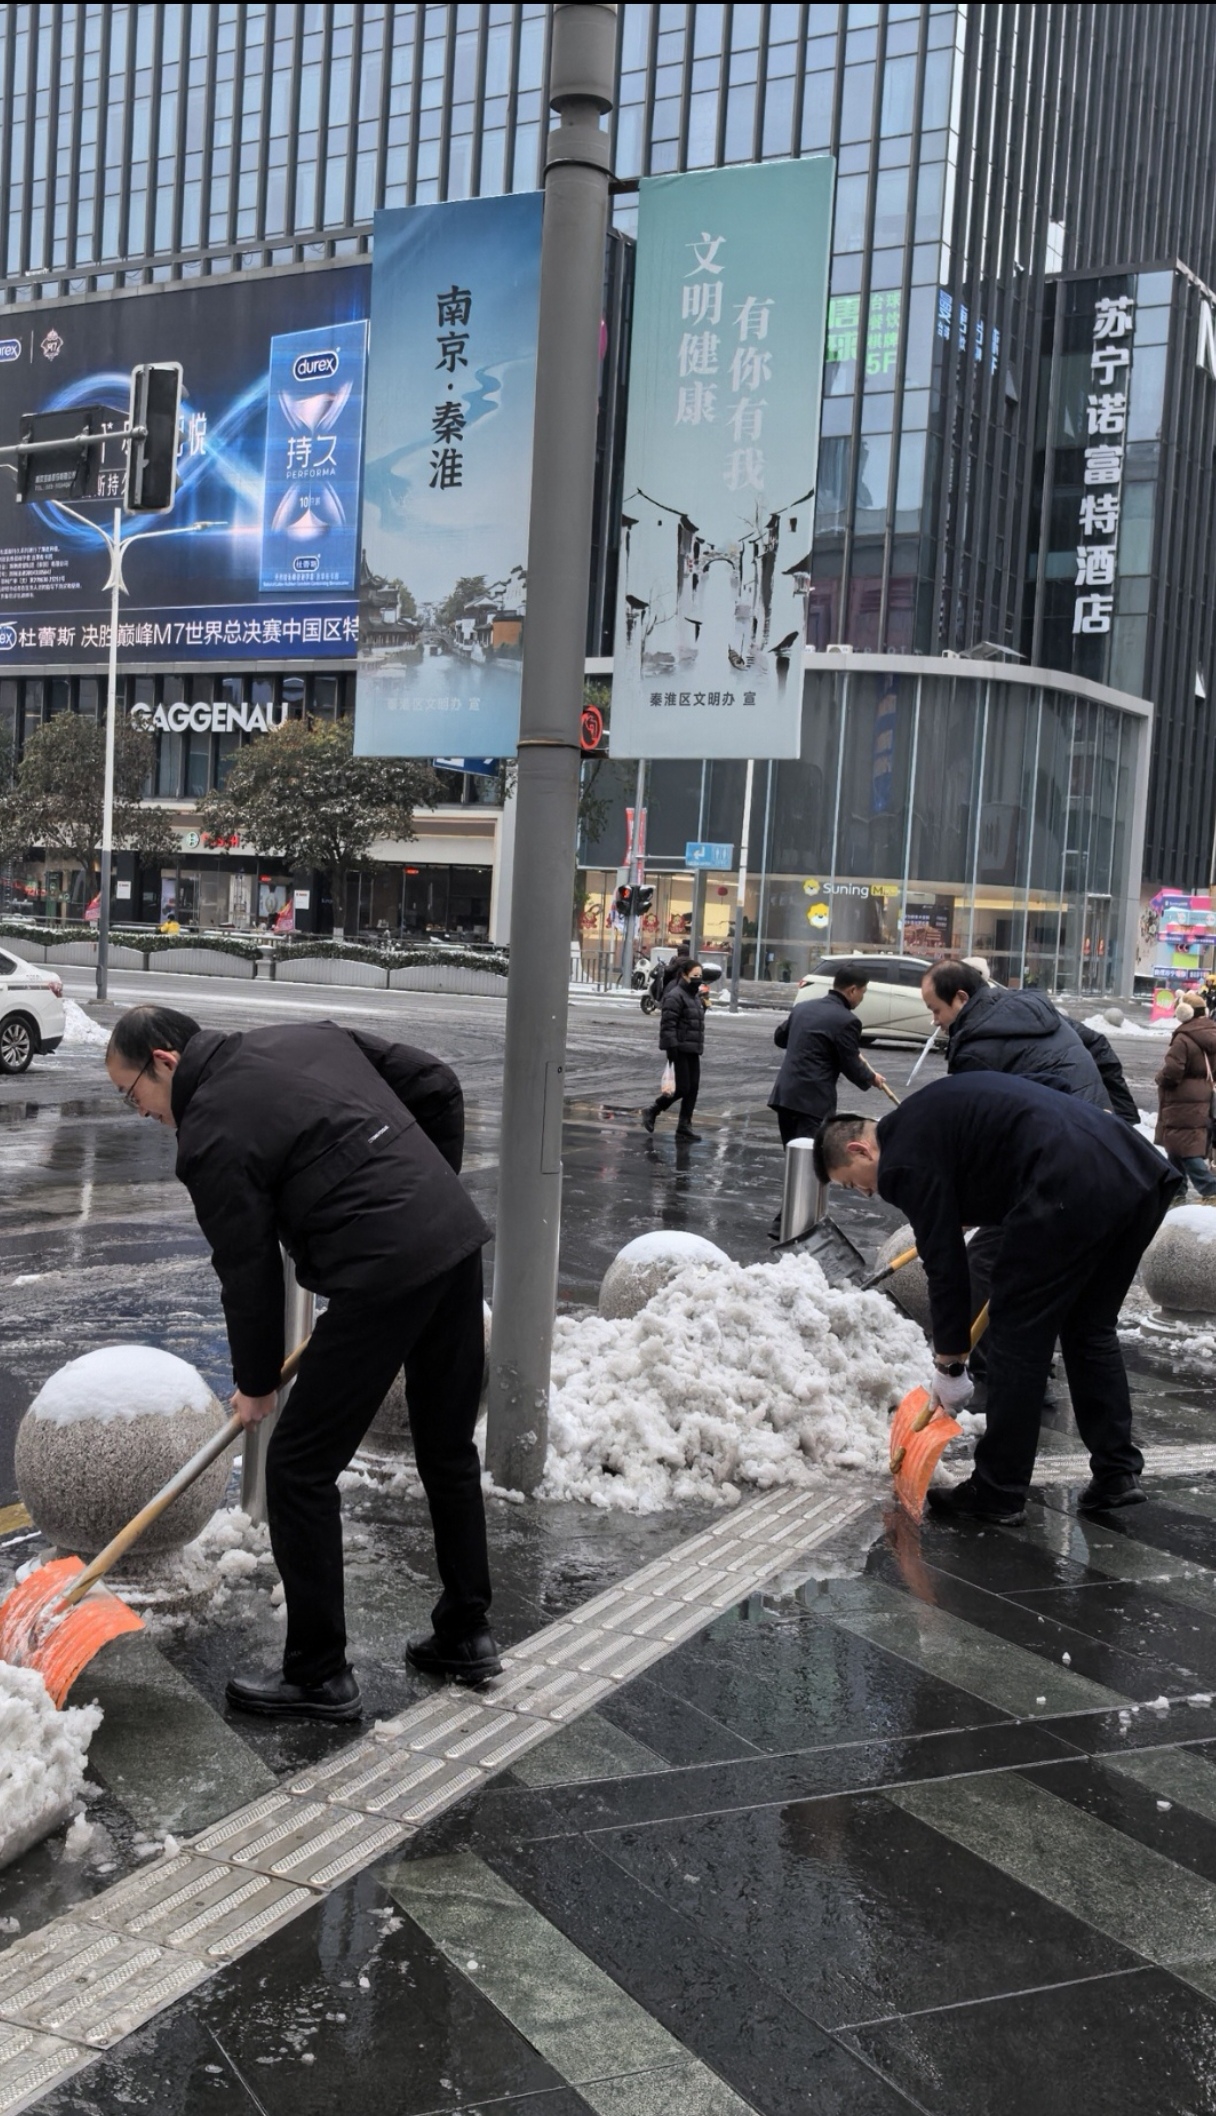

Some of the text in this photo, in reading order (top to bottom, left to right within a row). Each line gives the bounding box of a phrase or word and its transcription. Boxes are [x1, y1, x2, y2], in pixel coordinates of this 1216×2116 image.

[675, 231, 727, 427] 文明健康
[297, 357, 336, 376] durex
[866, 351, 898, 375] 5F
[429, 285, 472, 490] 南京·秦淮
[722, 295, 775, 492] 有你有我
[286, 467, 336, 479] PERFORMA
[1072, 295, 1135, 635] 苏宁诺富特酒店
[18, 626, 76, 648] 杜蕾斯
[650, 691, 757, 707] 秦淮区文明办 宣
[130, 702, 289, 733] GAGGENAU
[822, 884, 870, 899] Suning
